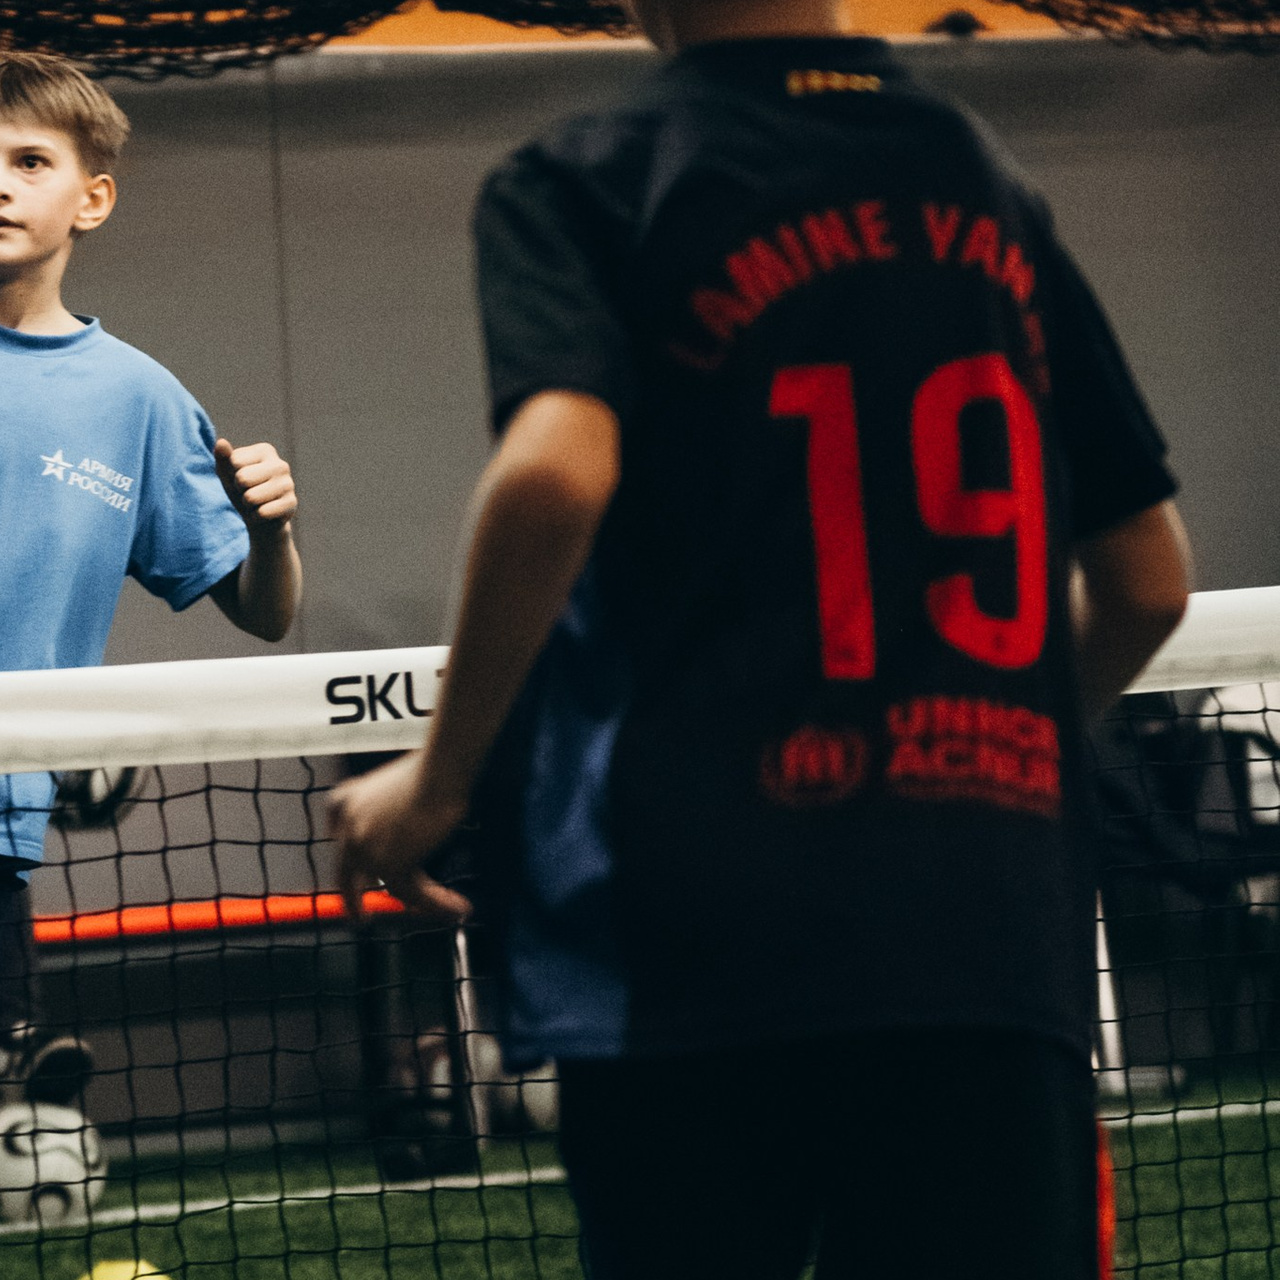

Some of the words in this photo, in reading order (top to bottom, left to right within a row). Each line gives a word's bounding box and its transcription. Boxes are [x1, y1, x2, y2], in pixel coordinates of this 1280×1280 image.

[67, 471, 134, 513] РОССИИ
[77, 457, 135, 492] АРМИЯ
[770, 351, 1050, 680] 19
[325, 668, 447, 726] SKL
